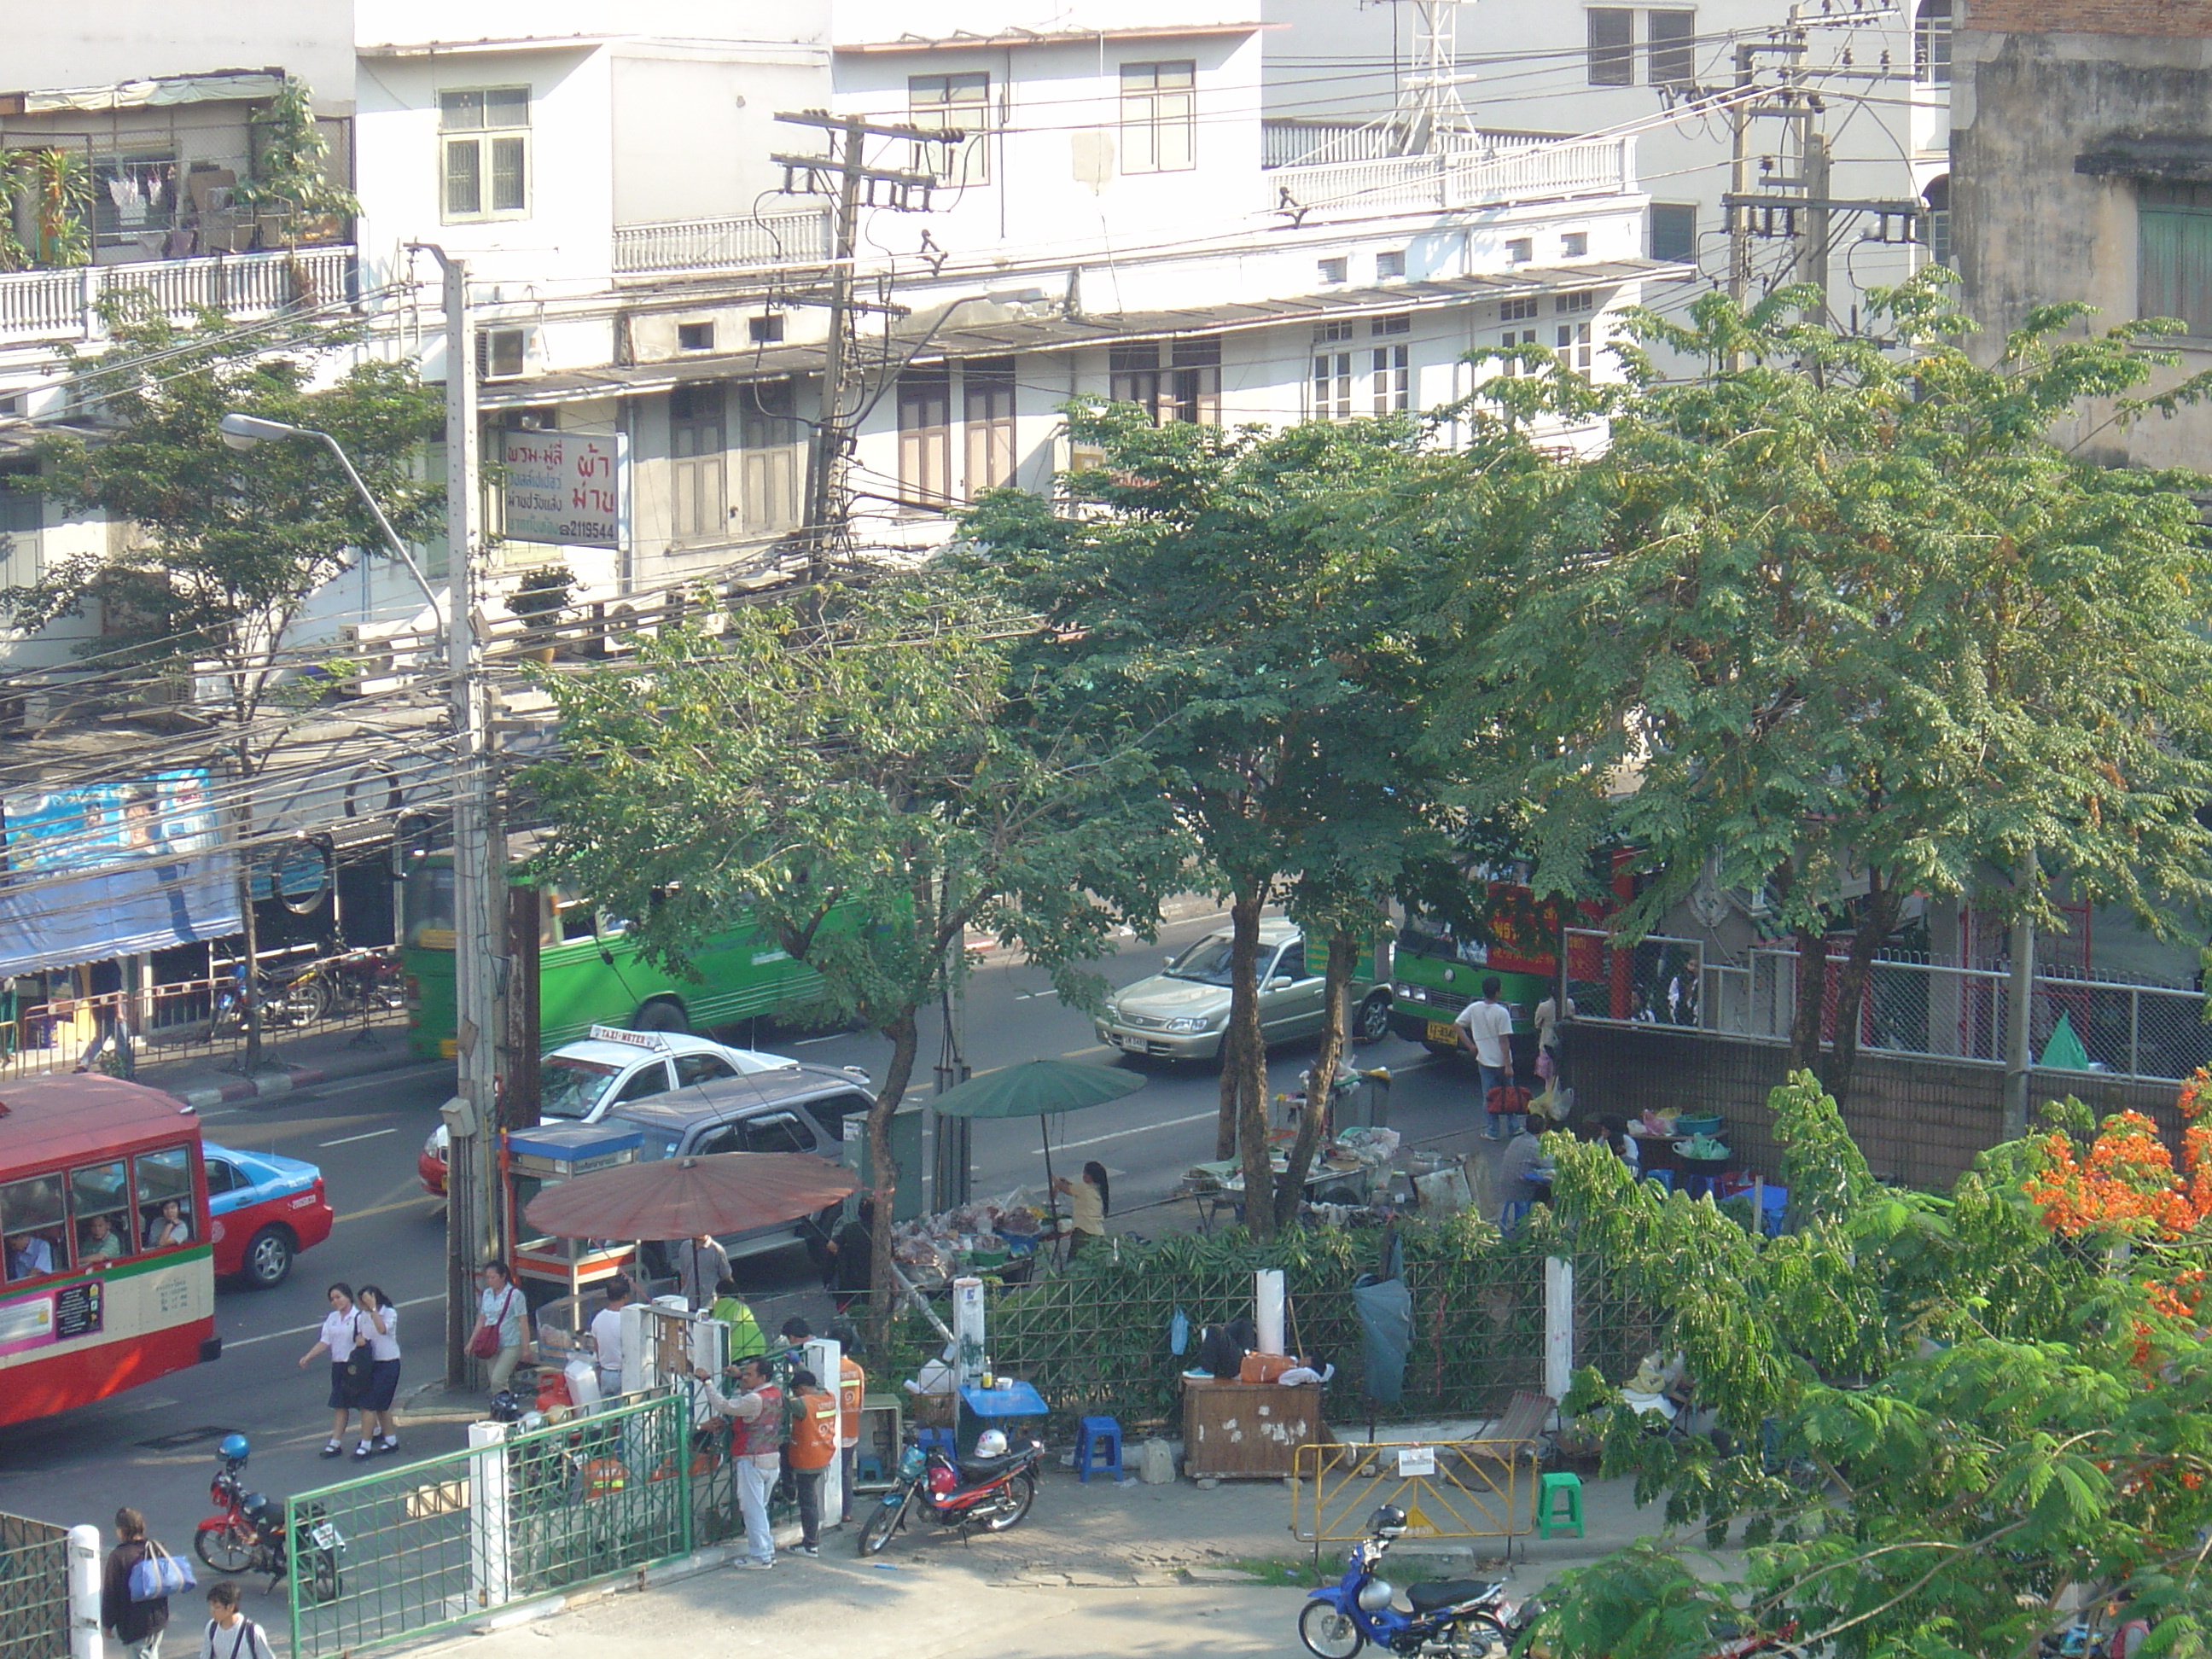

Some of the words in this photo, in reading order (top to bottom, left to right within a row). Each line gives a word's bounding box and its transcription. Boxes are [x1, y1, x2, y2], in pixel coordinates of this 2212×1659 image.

[578, 443, 608, 478] ผ้า
[572, 480, 614, 513] ม่าน
[570, 520, 614, 539] 2119544
